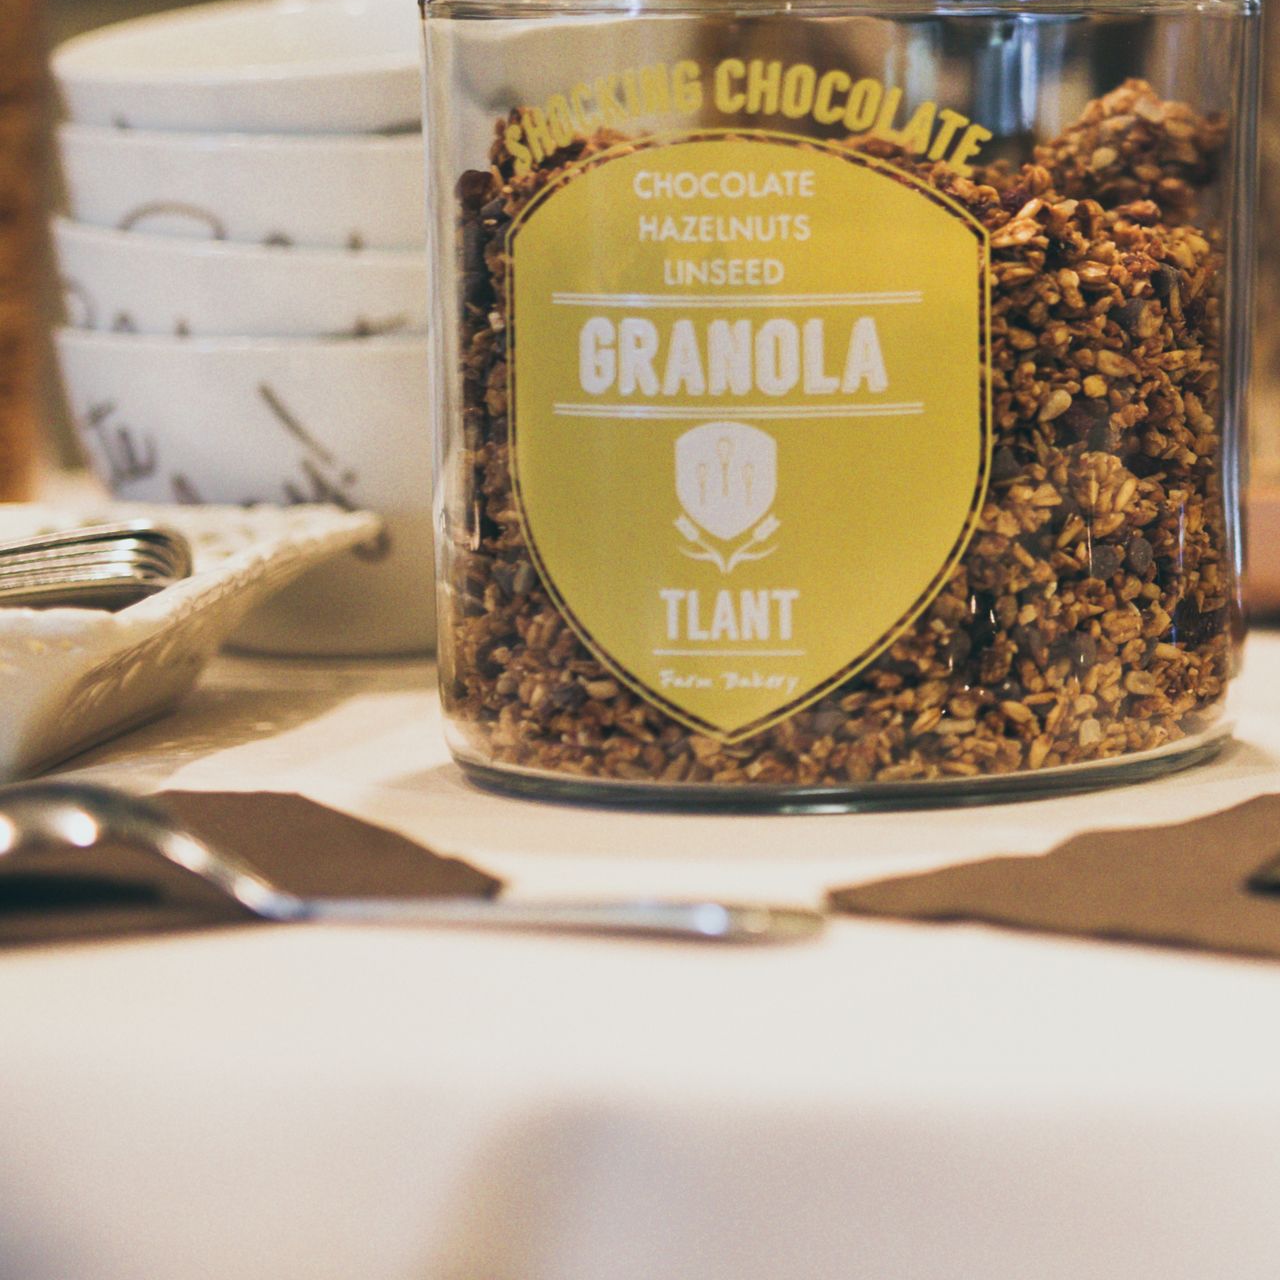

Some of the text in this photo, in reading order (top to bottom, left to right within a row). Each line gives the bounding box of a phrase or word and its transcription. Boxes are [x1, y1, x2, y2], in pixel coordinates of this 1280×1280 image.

[505, 58, 994, 178] SHOCKING CHOCOLATE
[633, 170, 815, 200] CHOCOLATE
[639, 214, 811, 243] HAZELNUTS
[663, 258, 785, 286] LINSEED
[578, 316, 889, 397] GRANOLA
[659, 588, 799, 641] TLANT
